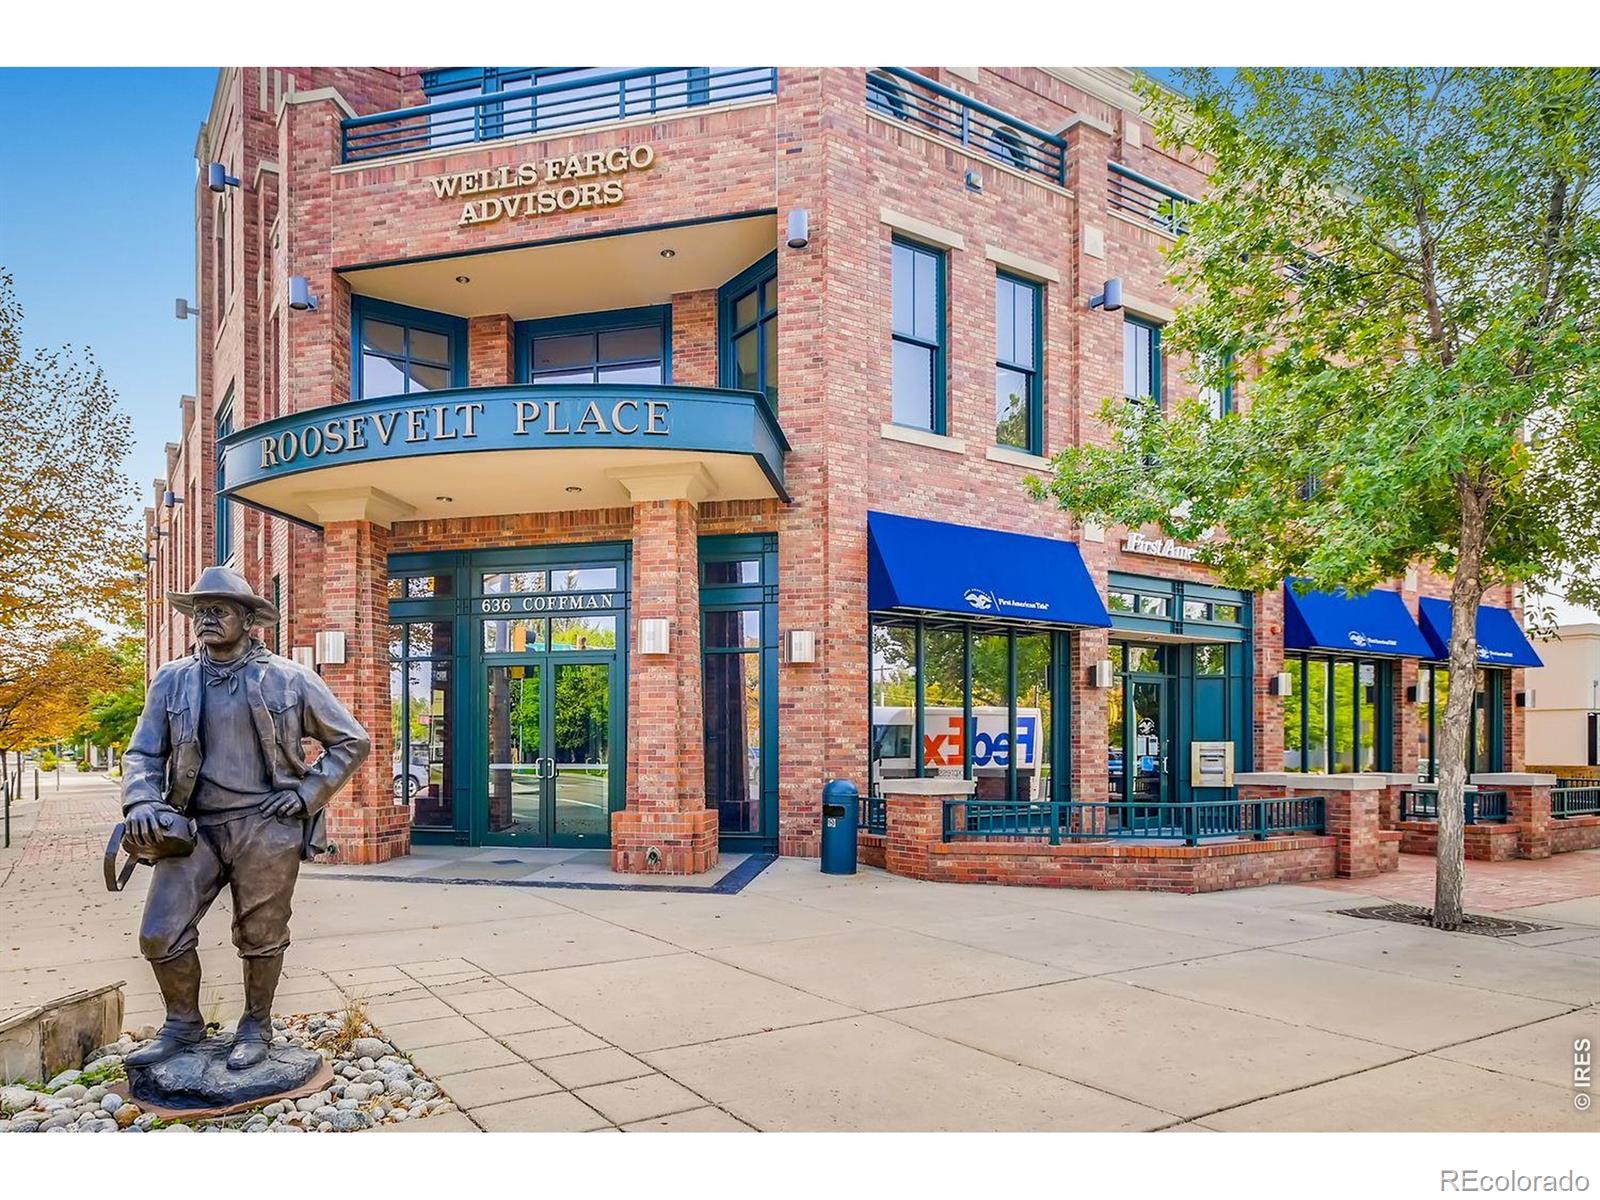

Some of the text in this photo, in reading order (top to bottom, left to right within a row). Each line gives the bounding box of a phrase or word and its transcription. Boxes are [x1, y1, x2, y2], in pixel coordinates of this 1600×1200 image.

[430, 144, 654, 199] WELLS FARGO
[457, 180, 624, 226] ADVISORS
[258, 400, 671, 469] ROOSEVELT PLACE
[1121, 532, 1164, 558] First
[481, 593, 614, 613] 636 COFFMAN
